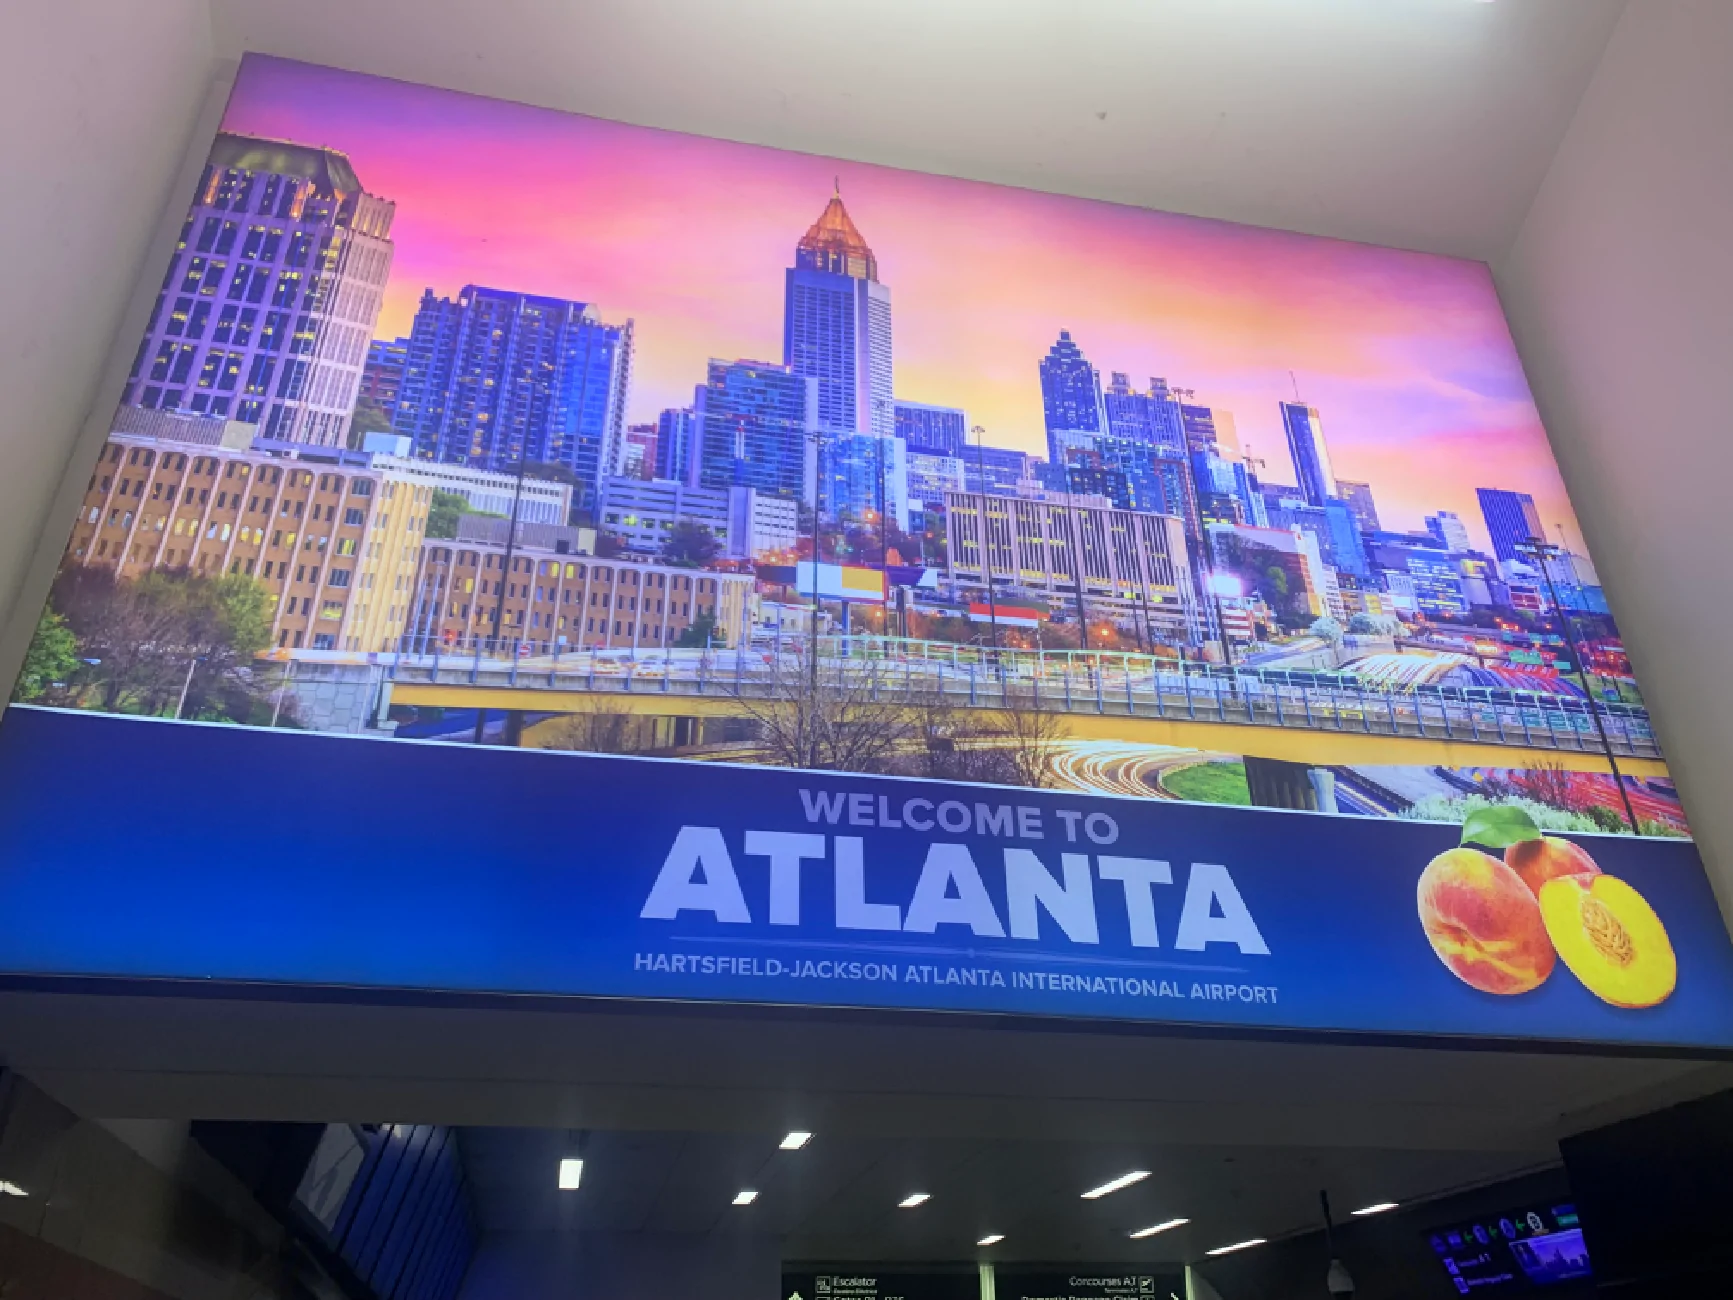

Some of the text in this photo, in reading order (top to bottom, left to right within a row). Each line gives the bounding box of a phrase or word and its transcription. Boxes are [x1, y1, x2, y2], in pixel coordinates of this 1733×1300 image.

[799, 789, 1119, 845] WELCOME TO
[640, 825, 1271, 955] ATLANTA
[634, 953, 1278, 1004] HARTSFIELD-JACKSON ATLANTA INTERNATIONAL AIRPORT
[833, 1276, 877, 1287] Escalator
